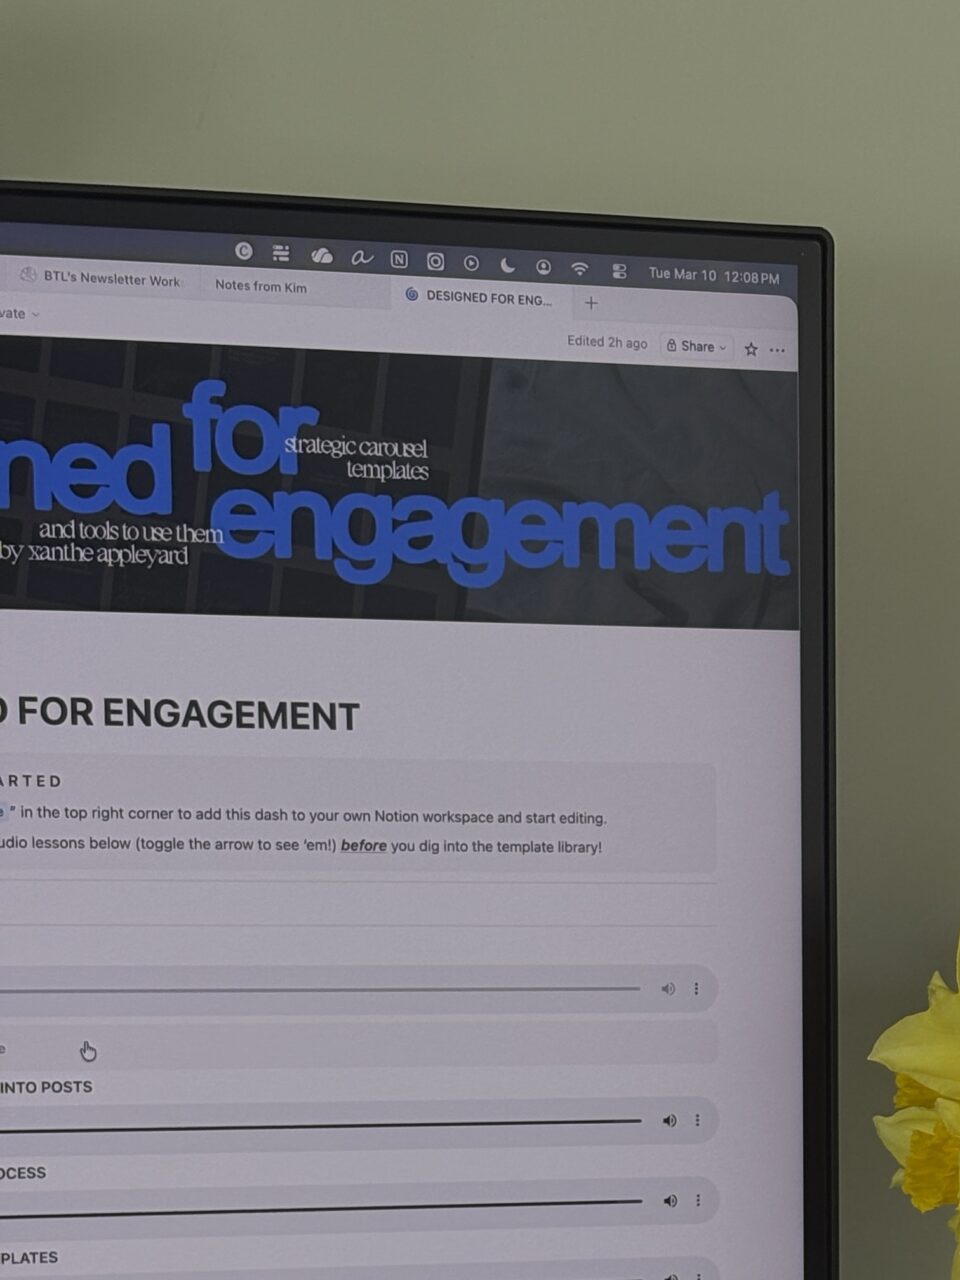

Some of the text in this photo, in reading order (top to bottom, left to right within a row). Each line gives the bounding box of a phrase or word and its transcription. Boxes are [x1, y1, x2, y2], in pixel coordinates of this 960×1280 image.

[44, 270, 77, 282] BTL's
[81, 272, 146, 285] Newsletter
[649, 267, 670, 278] Tue
[674, 268, 697, 280] Mar
[702, 270, 716, 281] 10
[216, 279, 307, 293] Notes from Kim
[427, 290, 487, 303] DESIGNED
[491, 293, 514, 304] FOR
[568, 335, 647, 351] Edited 2h ago
[682, 340, 714, 352] Share
[183, 379, 319, 475] for
[285, 435, 428, 459] strategic carousel
[347, 460, 429, 483] templates
[39, 520, 224, 544] and tools to use them
[210, 488, 791, 589] engagement
[0, 541, 189, 568] by xanthe appleyard
[19, 696, 93, 726] FOR
[104, 698, 360, 730] ENGAGEMENT
[21, 805, 607, 827] in the top right corner to add this dash to your own Notion workspace and start editing.
[32, 836, 85, 849] lessons
[90, 837, 131, 849] below
[136, 837, 184, 852] (toggle
[189, 838, 211, 850] the
[215, 841, 253, 850] arrow
[258, 840, 271, 850] to
[276, 841, 299, 851] see
[341, 839, 387, 853] before
[391, 842, 415, 854] you
[419, 840, 439, 854] dig
[444, 840, 468, 852] into
[472, 840, 493, 852] the
[497, 841, 554, 855] template
[558, 841, 602, 855] library!
[0, 1081, 92, 1094] INTO POSTS
[1, 1251, 58, 1264] PLATES
